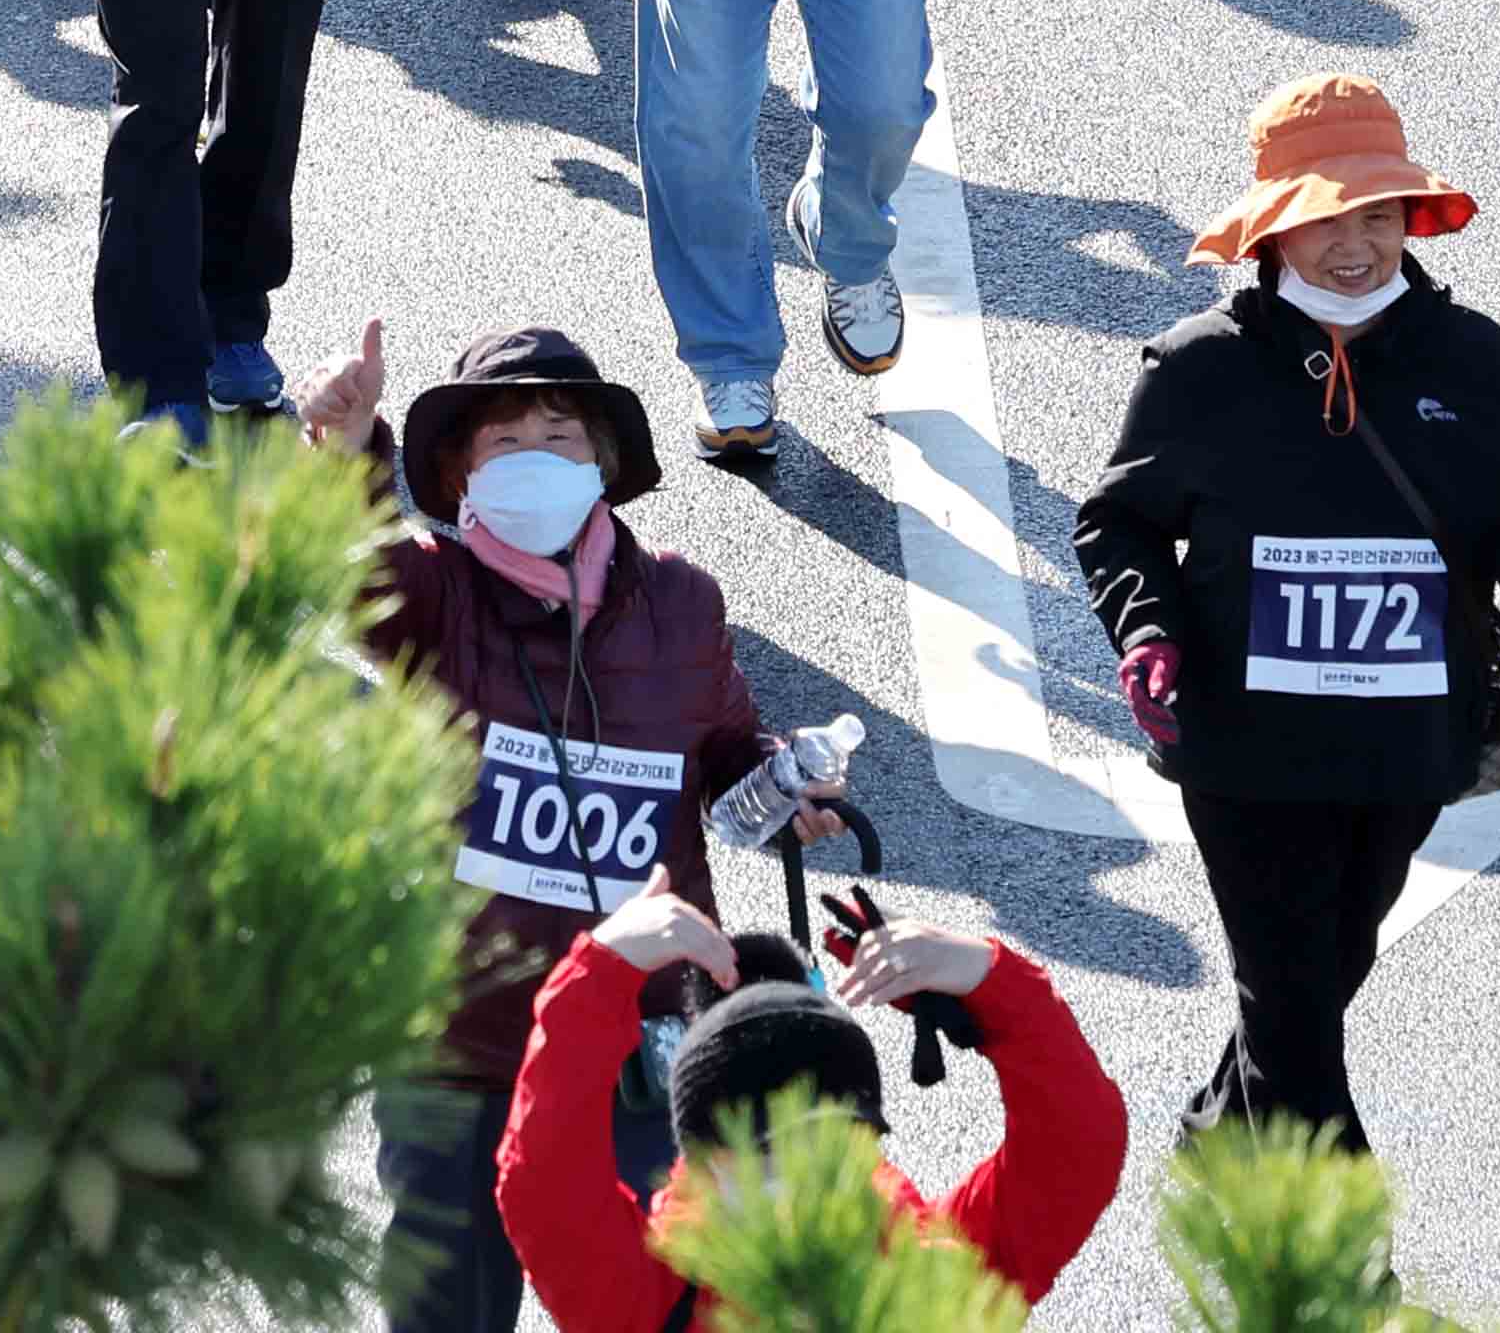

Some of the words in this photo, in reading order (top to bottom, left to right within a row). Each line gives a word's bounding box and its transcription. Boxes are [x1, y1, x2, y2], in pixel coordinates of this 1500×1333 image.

[1262, 546, 1303, 564] 2023
[1279, 582, 1423, 651] 1172
[494, 735, 537, 760] 2023
[492, 774, 660, 870] 1006
